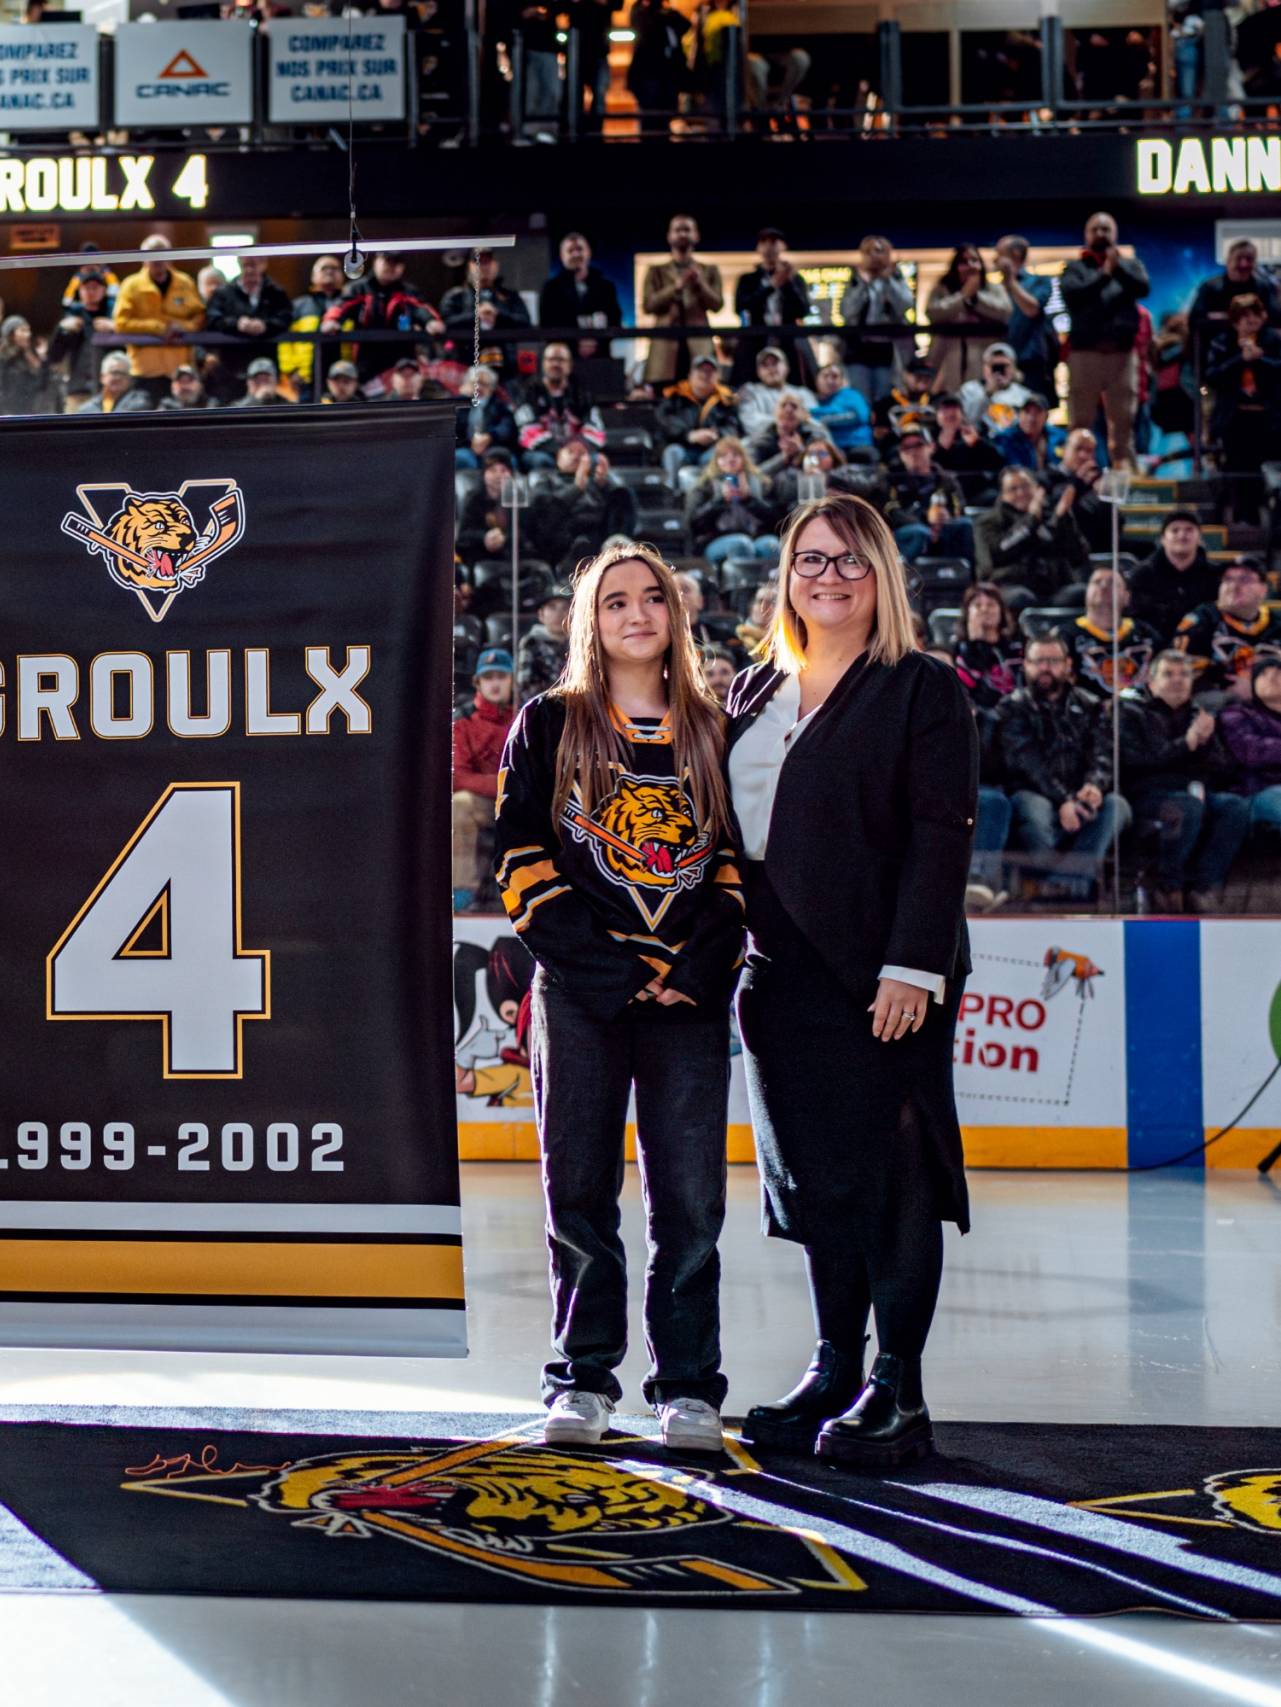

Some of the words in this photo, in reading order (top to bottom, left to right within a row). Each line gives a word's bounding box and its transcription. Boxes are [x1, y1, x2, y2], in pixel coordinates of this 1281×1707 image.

[288, 34, 385, 52] COMPAREZ
[9, 68, 50, 85] PRIX
[55, 67, 90, 83] SUR
[276, 60, 309, 77] NOS
[315, 59, 357, 77] PRIX
[363, 58, 397, 76] SUR
[135, 82, 231, 99] CANAC
[172, 154, 209, 209] 4
[1136, 136, 1281, 195] DANN
[46, 781, 271, 1079] 4
[953, 1028, 1039, 1073] ion
